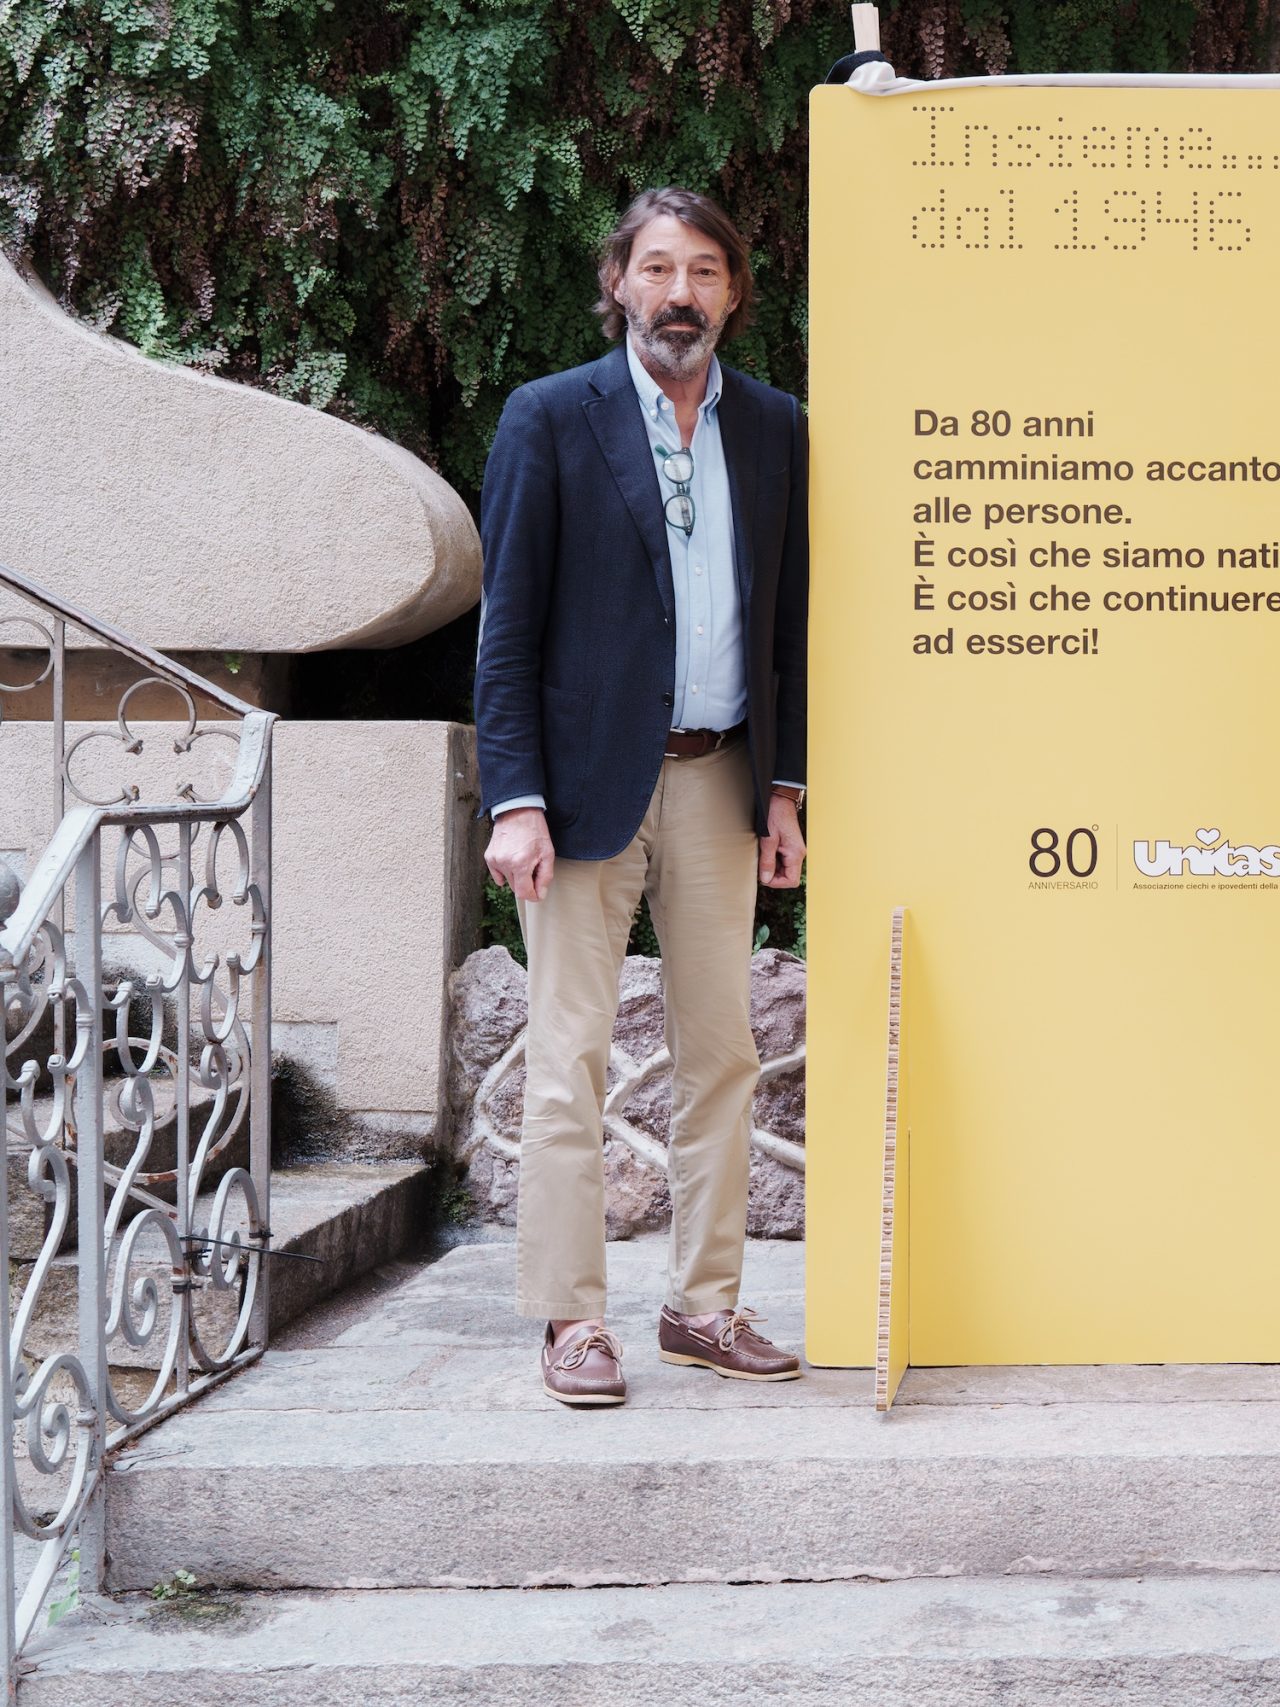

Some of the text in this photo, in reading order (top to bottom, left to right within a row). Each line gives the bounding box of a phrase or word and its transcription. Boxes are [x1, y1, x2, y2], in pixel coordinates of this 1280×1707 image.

[911, 188, 1251, 252] dal 1946
[914, 409, 1094, 438] Da 80 anni
[913, 453, 1134, 482] camminiamo
[912, 496, 1132, 531] alle persone.
[914, 531, 935, 567] È
[947, 537, 1017, 568] così
[1029, 540, 1091, 568] che
[1102, 540, 1205, 569] siamo
[914, 573, 935, 611] È
[947, 581, 1017, 612] così
[1029, 584, 1091, 612] che
[912, 626, 1099, 656] ad esserci!
[1027, 881, 1099, 890] ANNIVERSARIO
[1132, 882, 1185, 891] Associazione
[1187, 882, 1209, 891] ciechi
[1218, 882, 1258, 892] ipovedenti
[1260, 882, 1279, 890] della
